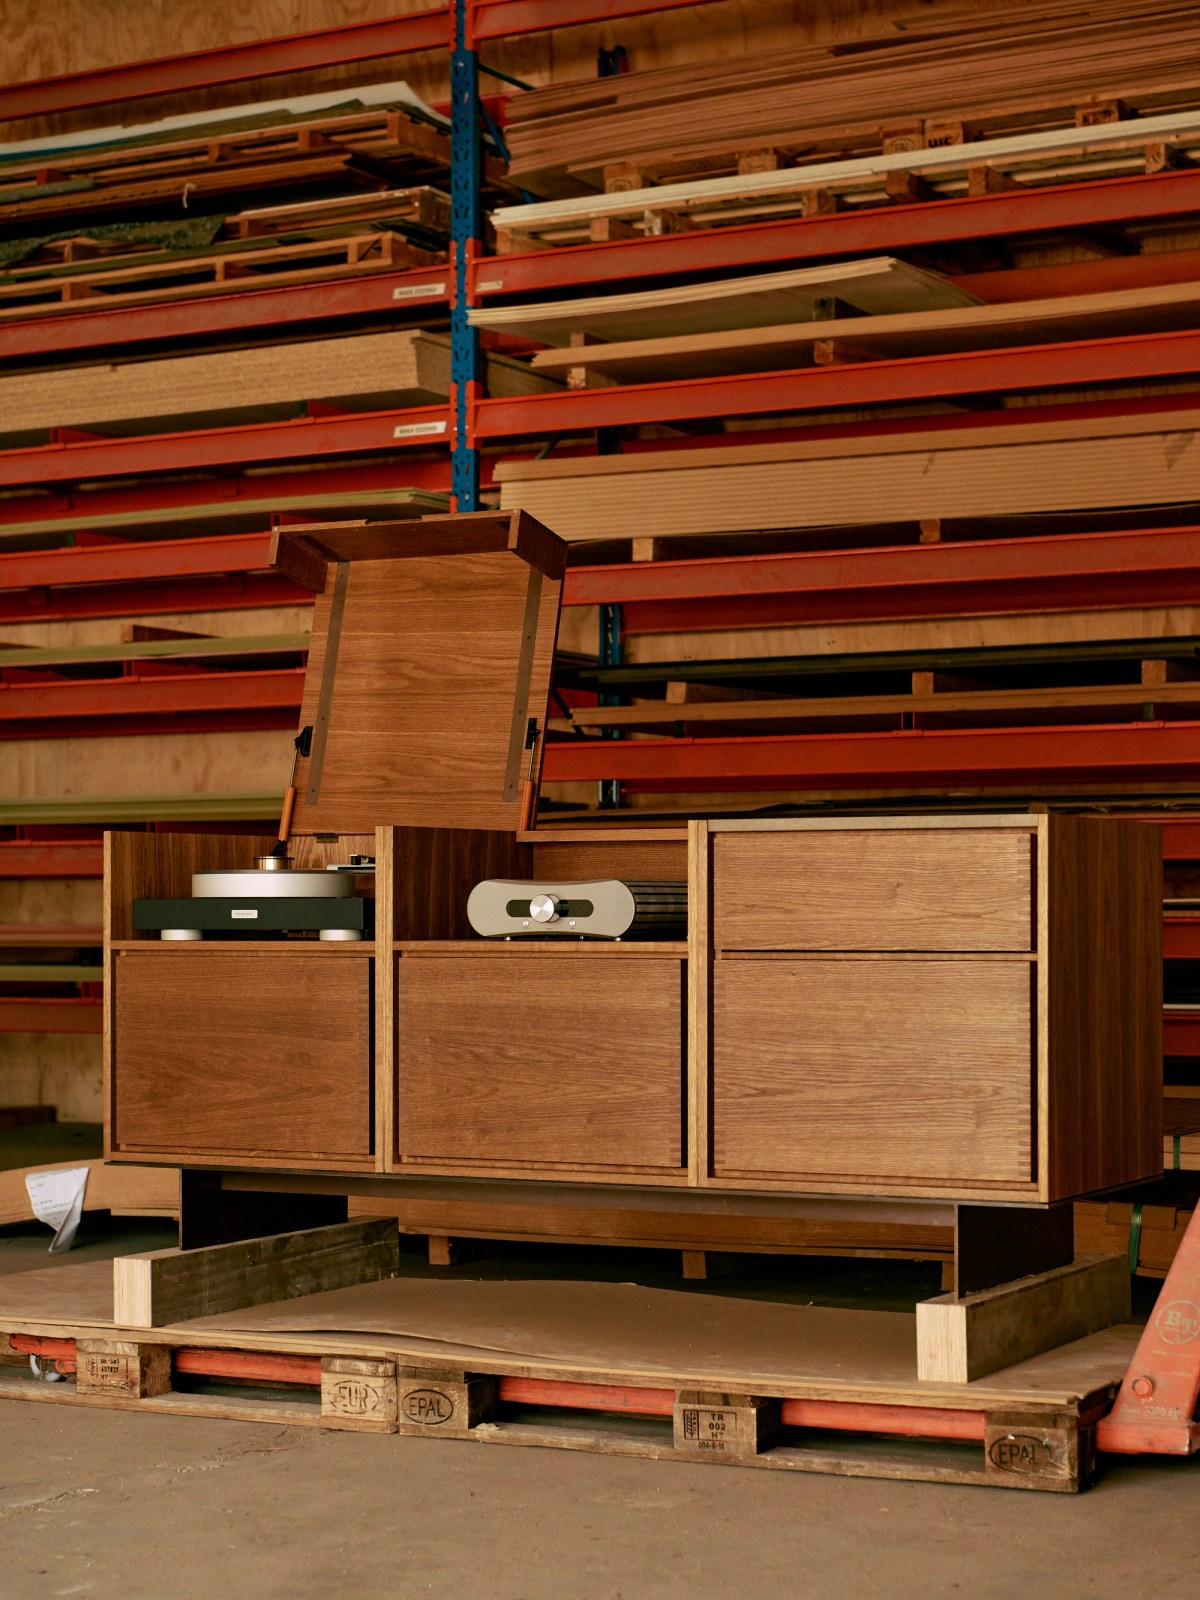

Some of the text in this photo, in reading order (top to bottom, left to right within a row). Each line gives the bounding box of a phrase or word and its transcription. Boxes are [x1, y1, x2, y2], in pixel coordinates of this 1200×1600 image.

[338, 1386, 368, 1409] EUR
[409, 1397, 445, 1417] EPAL
[708, 1422, 726, 1431] 002
[710, 1413, 724, 1421] TR
[998, 1443, 1040, 1465] EPAL
